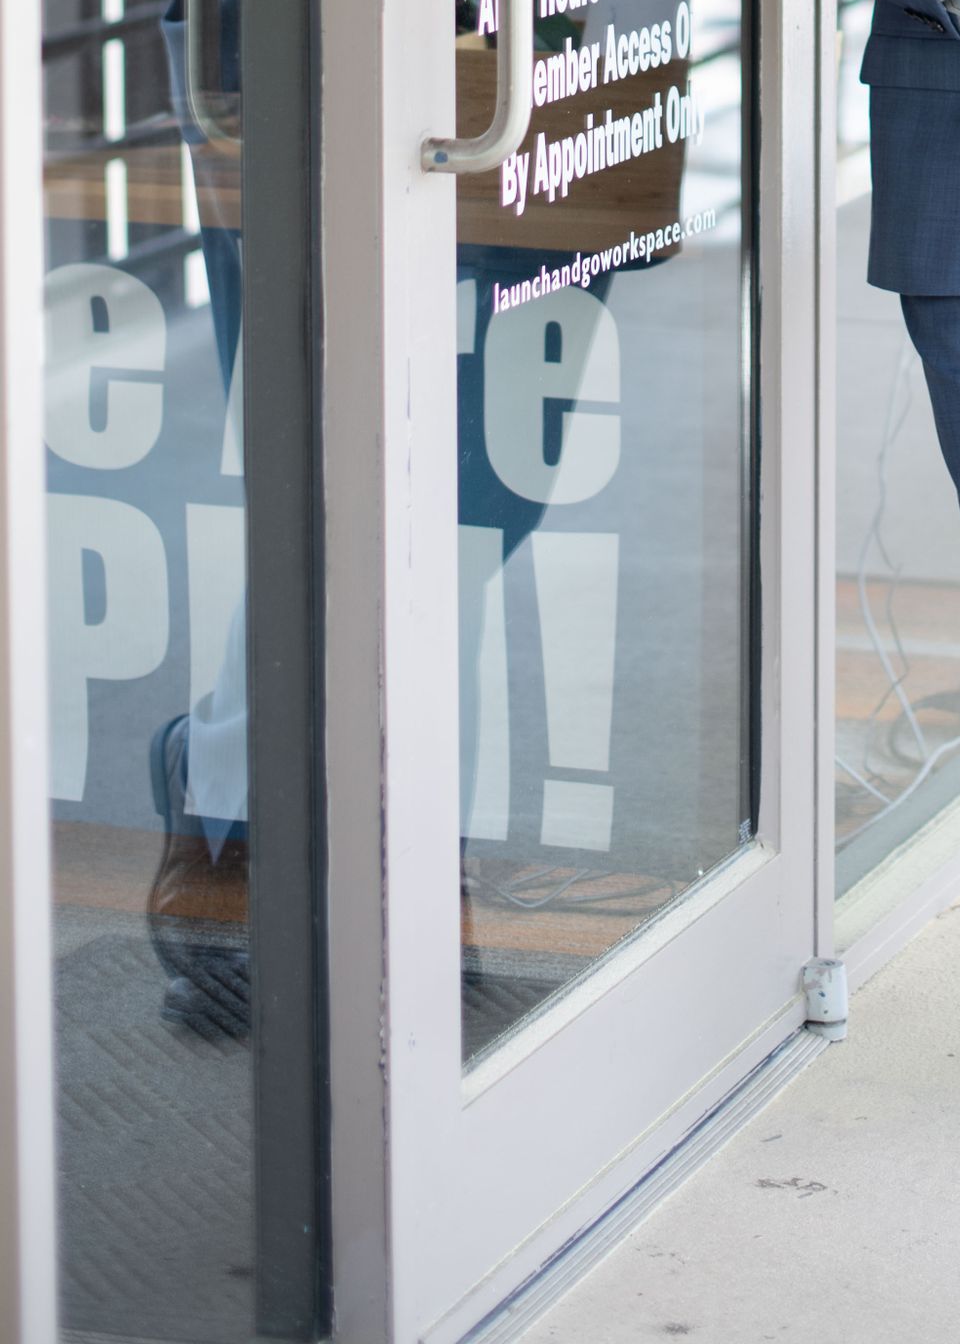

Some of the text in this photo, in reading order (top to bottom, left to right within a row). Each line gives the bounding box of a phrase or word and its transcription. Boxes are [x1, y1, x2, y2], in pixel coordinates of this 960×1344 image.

[531, 37, 600, 108] ember
[604, 24, 671, 84] Access
[502, 80, 705, 216] By Appointment Only
[494, 208, 717, 314] launchandgoworkspace.com
